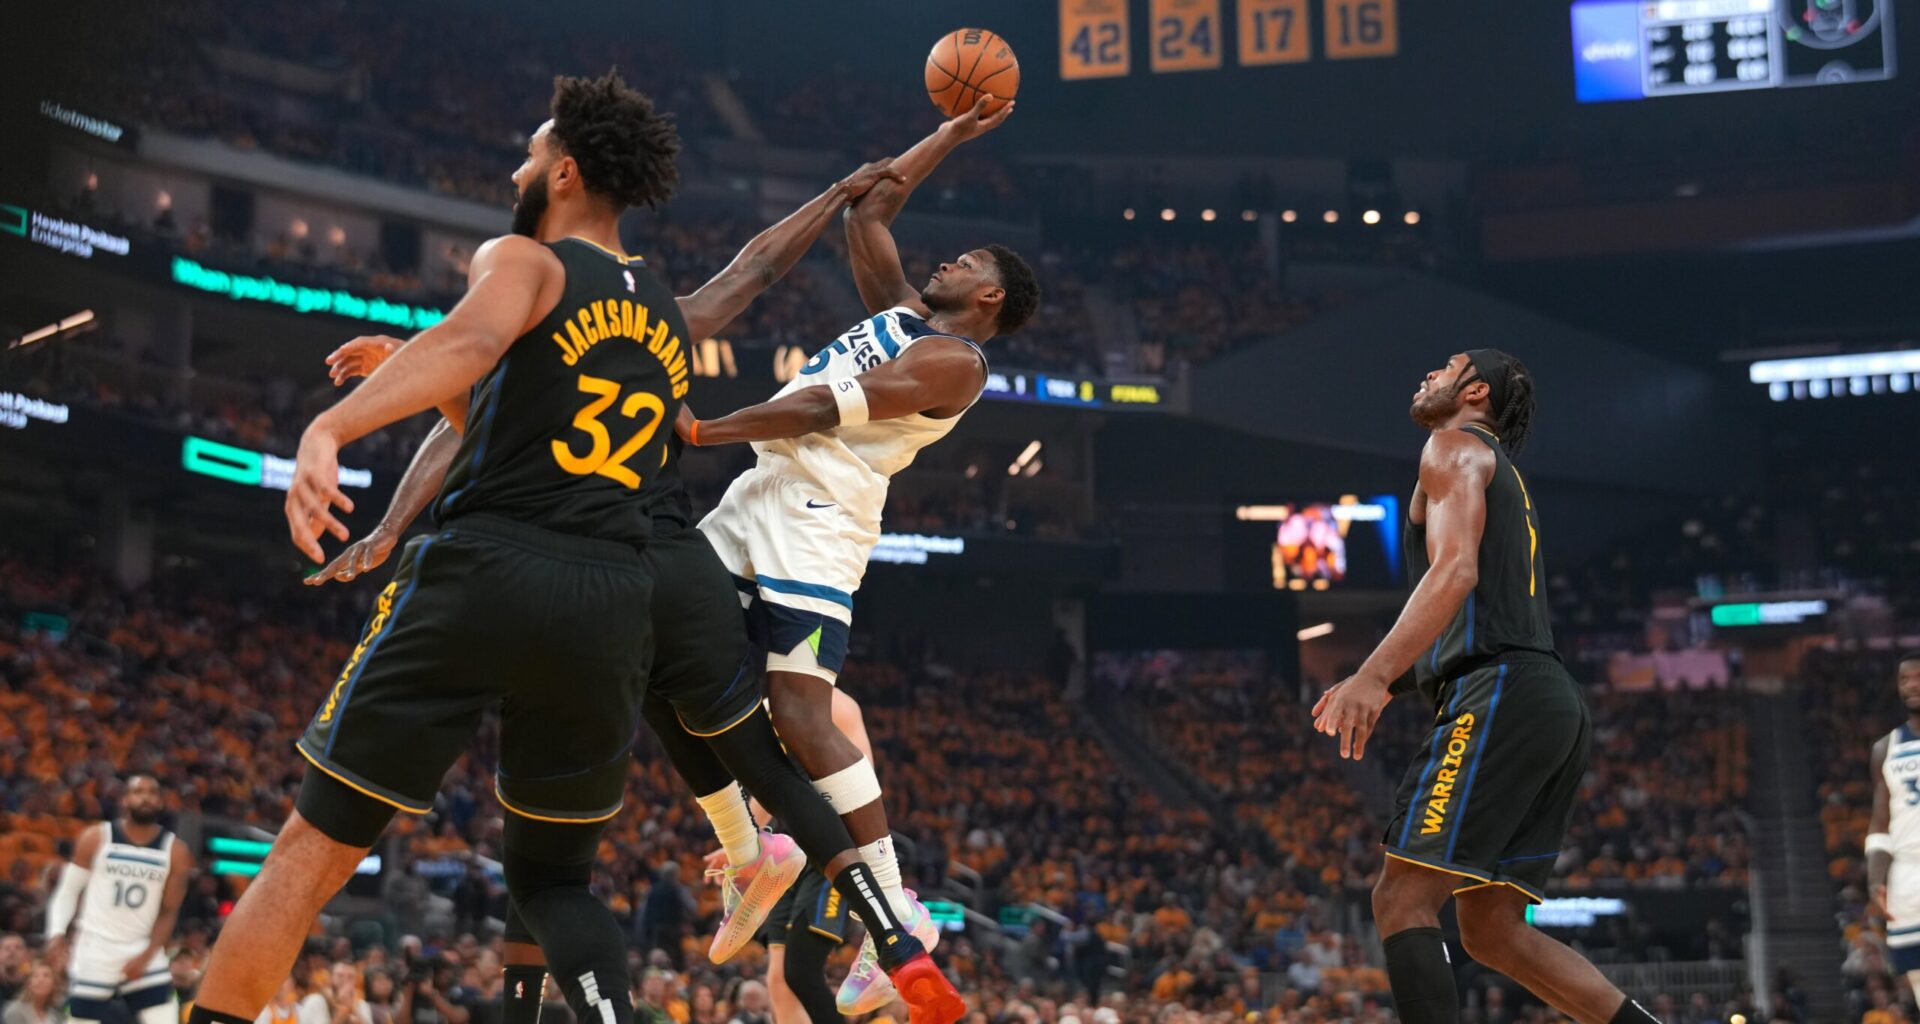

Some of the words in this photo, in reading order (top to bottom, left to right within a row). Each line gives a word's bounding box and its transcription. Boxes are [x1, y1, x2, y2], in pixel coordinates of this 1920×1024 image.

[1070, 23, 1121, 65] 42
[1160, 16, 1212, 59] 24
[1254, 9, 1294, 53] 17
[1339, 2, 1382, 46] 16
[40, 101, 123, 142] ticketmaster
[552, 299, 690, 400] JACKSON-DAVIS
[838, 380, 854, 393] 5
[551, 374, 666, 490] 32
[1420, 712, 1476, 835] WARRIORS
[106, 863, 165, 882] WOLVES
[114, 880, 148, 910] 10
